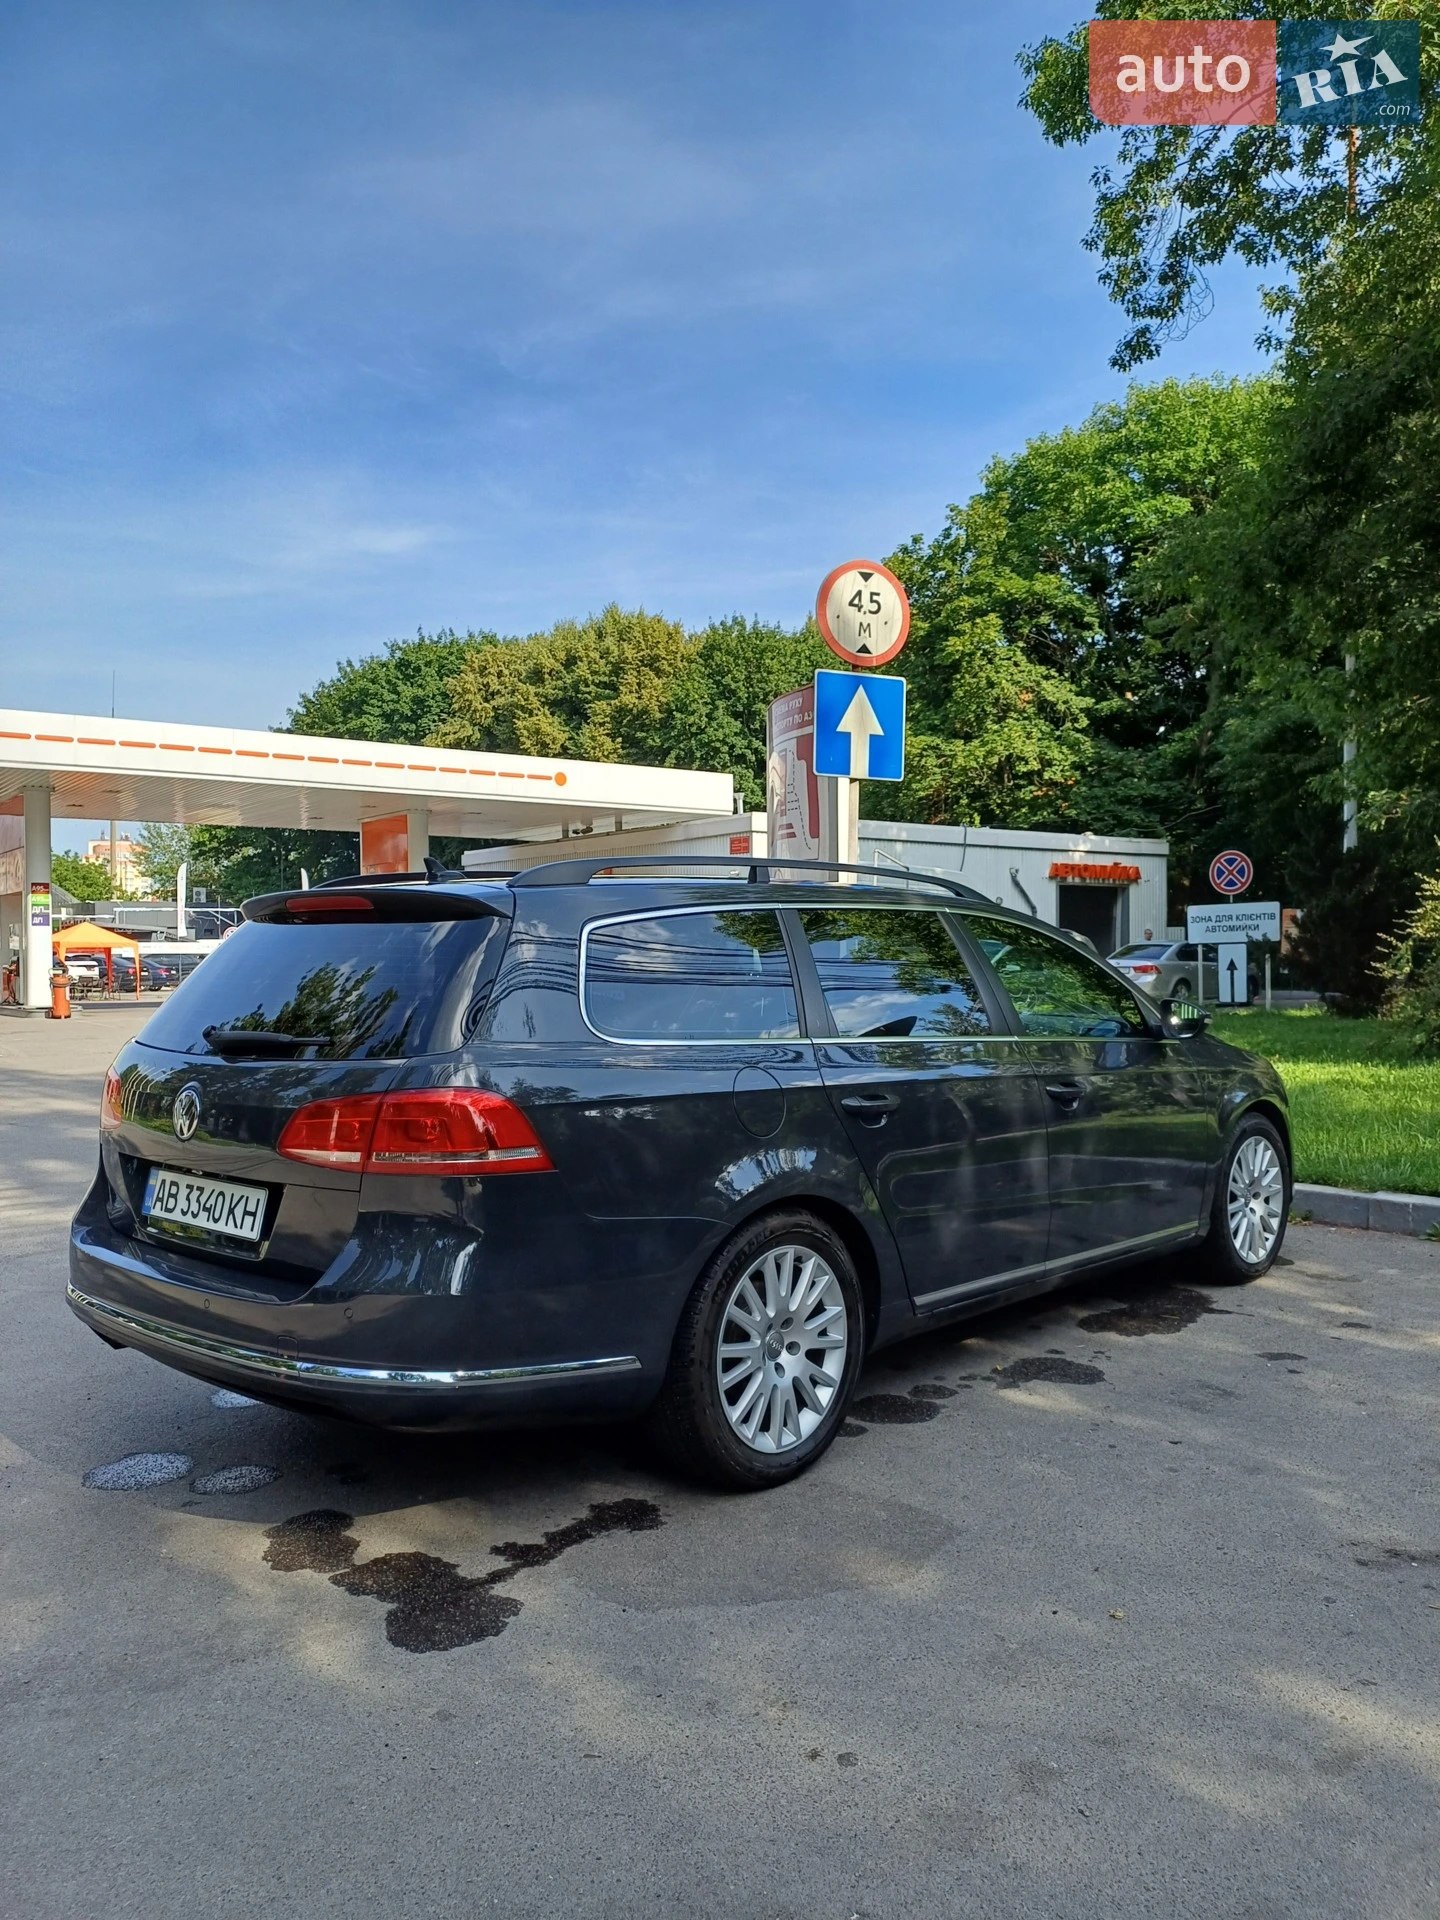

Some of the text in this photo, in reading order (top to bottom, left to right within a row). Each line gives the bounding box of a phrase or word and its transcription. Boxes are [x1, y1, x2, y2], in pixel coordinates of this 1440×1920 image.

[804, 711, 813, 721] АЗ
[1048, 862, 1142, 881] АВТОМИЙКА
[1190, 912, 1276, 924] ЗОНА ДЛЯ КЛІЄНТІВ
[1205, 922, 1260, 933] АВТОМИЙКИ
